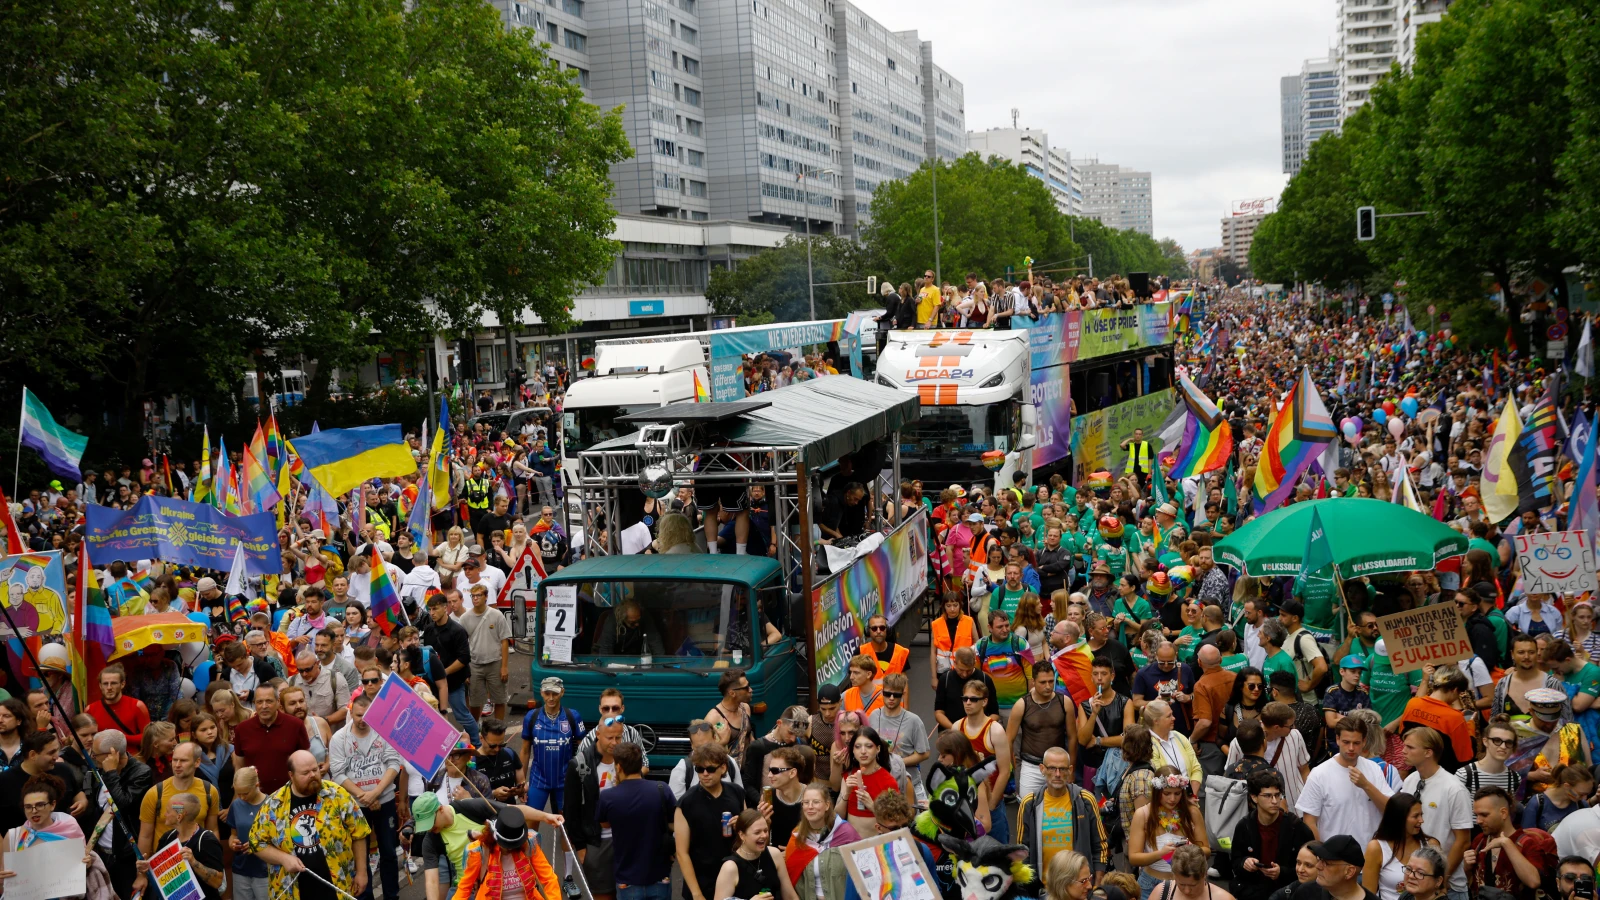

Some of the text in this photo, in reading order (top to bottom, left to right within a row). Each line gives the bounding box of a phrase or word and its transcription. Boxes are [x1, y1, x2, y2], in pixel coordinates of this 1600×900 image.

[1085, 318, 1108, 334] HUSE
[1109, 317, 1117, 331] OF
[1117, 315, 1138, 329] PRIDE
[768, 330, 780, 348] NIE
[780, 326, 806, 346] WIEDER
[714, 373, 736, 387] different
[715, 386, 737, 399] together
[1031, 379, 1063, 404] ROTECT
[998, 441, 1005, 451] 4
[160, 506, 195, 521] Ukraine
[188, 532, 269, 552] gleiche Rchte
[1516, 531, 1584, 553] JETZT
[1352, 556, 1417, 572] VOLKSSOLIDARITÄT
[554, 609, 567, 632] 2
[1384, 607, 1456, 631] HUMANITARIAN
[1394, 618, 1458, 639] AID FOR THE
[815, 611, 854, 651] Inklusion
[1401, 629, 1456, 648] PEOPLE OF
[1392, 639, 1471, 668] SUWEIDA
[816, 656, 841, 685] nicht
[161, 865, 182, 885] SONNE
[165, 874, 187, 897] NATUR
